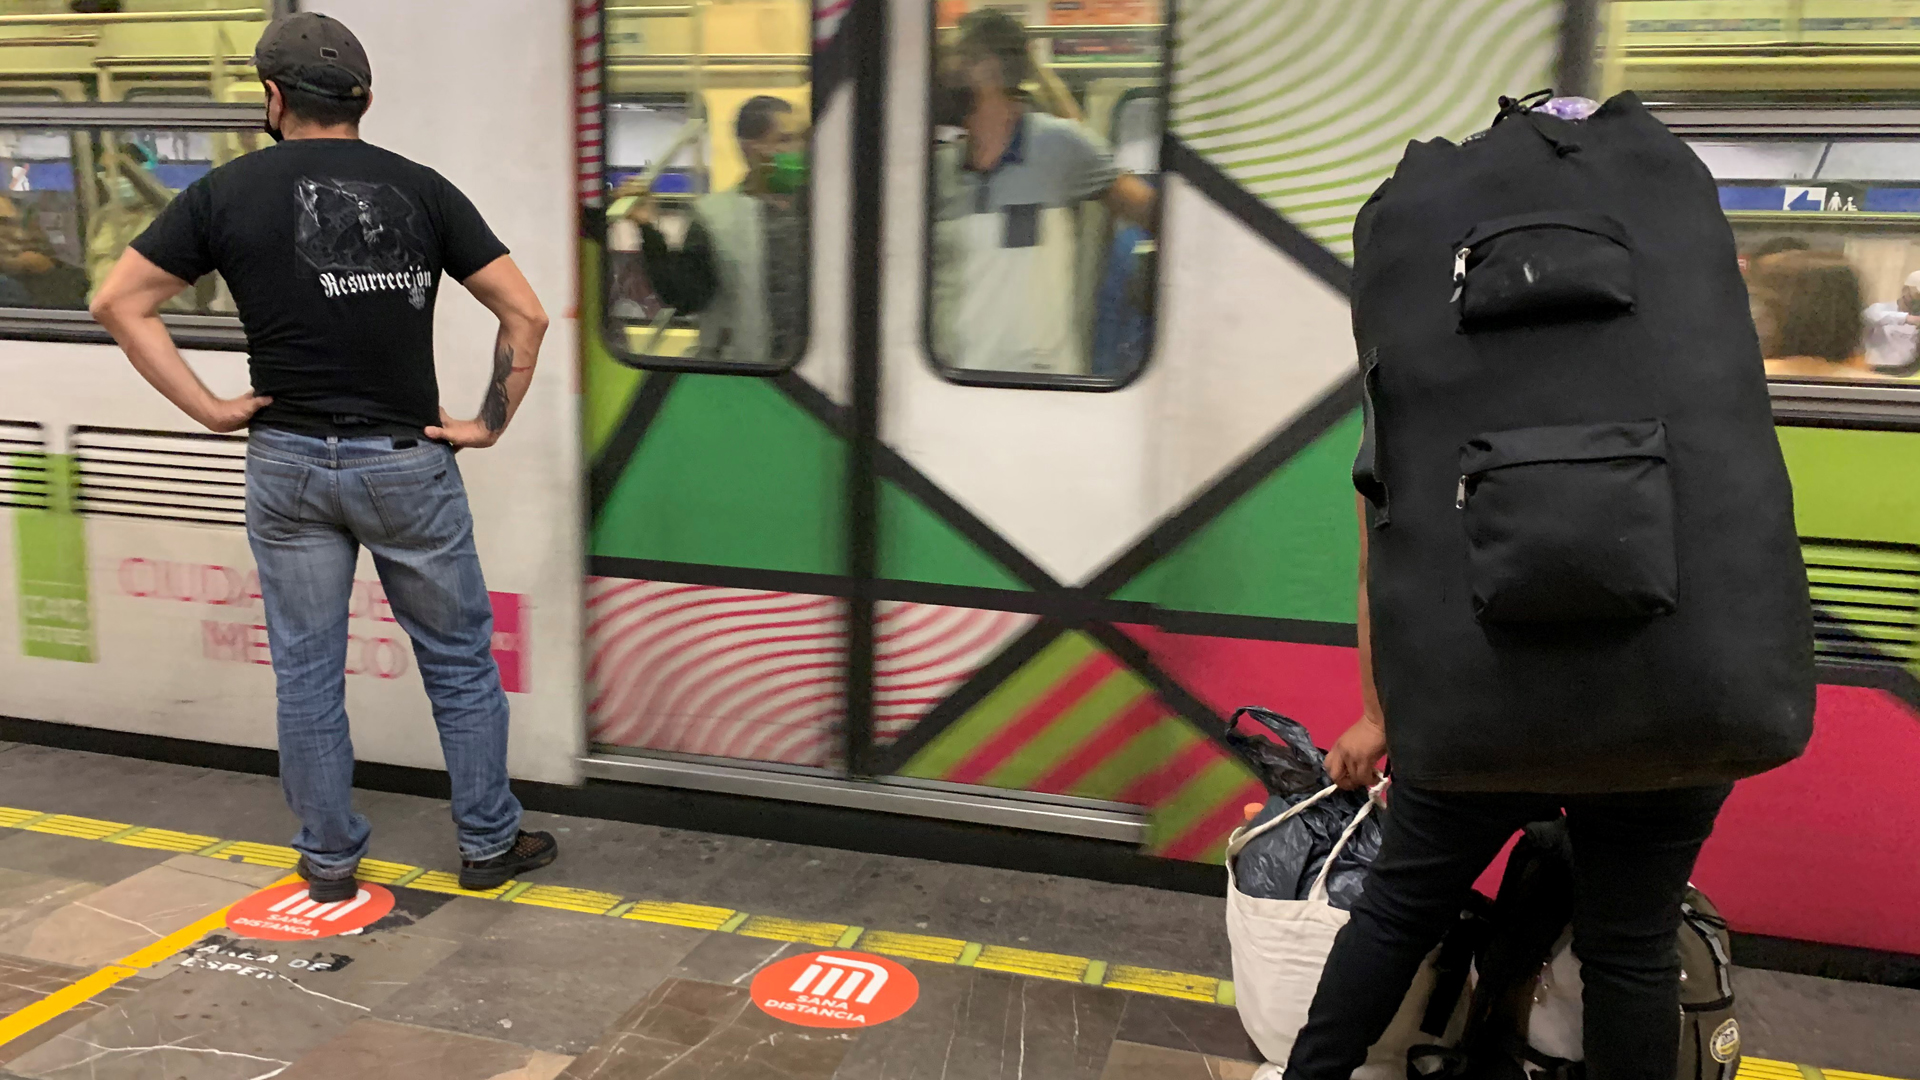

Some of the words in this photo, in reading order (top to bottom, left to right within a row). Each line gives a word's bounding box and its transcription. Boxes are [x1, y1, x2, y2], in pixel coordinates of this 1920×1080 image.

[117, 556, 263, 607] CIUDA
[233, 917, 320, 937] DISTANCIA
[267, 914, 313, 927] SANA
[764, 999, 866, 1023] DISTANCIA
[796, 995, 848, 1010] SANA
